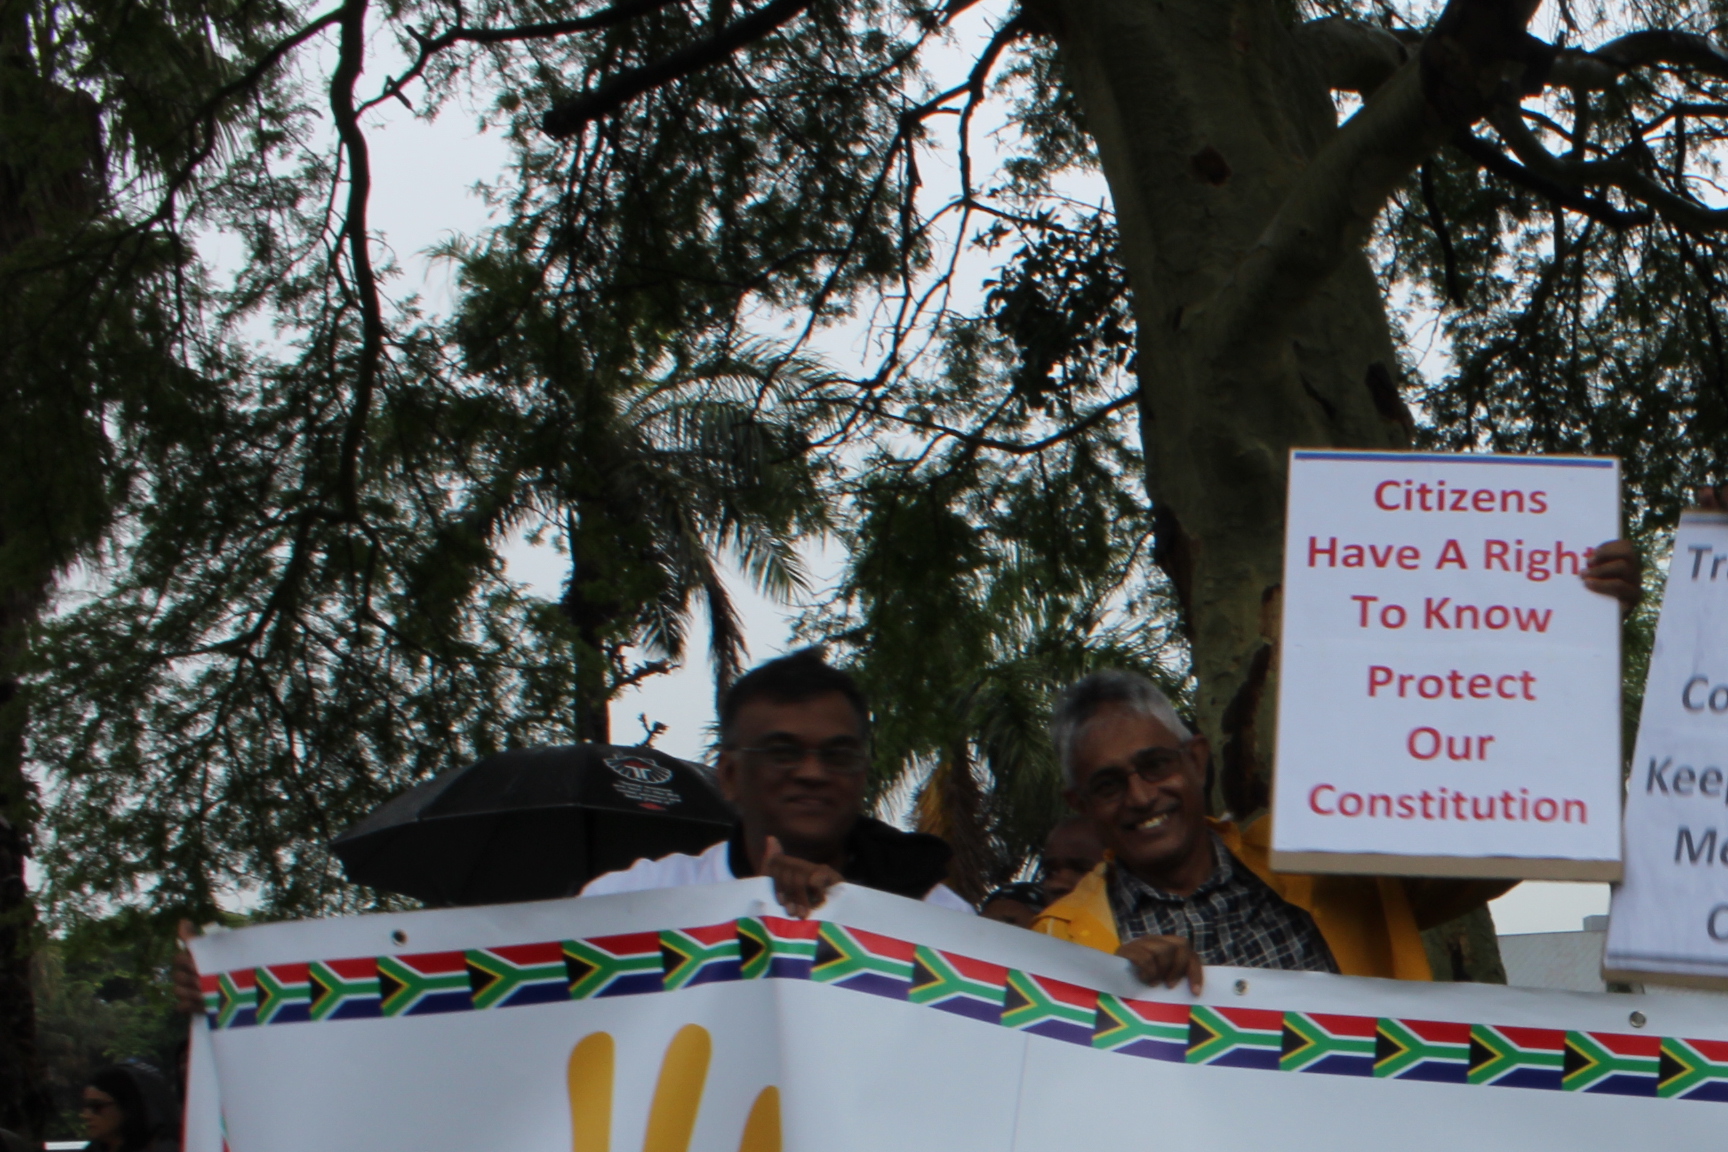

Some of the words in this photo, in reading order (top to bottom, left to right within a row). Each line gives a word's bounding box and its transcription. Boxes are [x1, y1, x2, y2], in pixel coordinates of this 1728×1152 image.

[1374, 479, 1548, 514] Citizens
[1307, 535, 1421, 571] Have
[1435, 538, 1468, 570] A
[1350, 594, 1407, 629] To
[1424, 597, 1553, 633] Know
[1368, 665, 1536, 701] Protect
[1406, 726, 1495, 761] Our
[1308, 783, 1587, 824] Constitution
